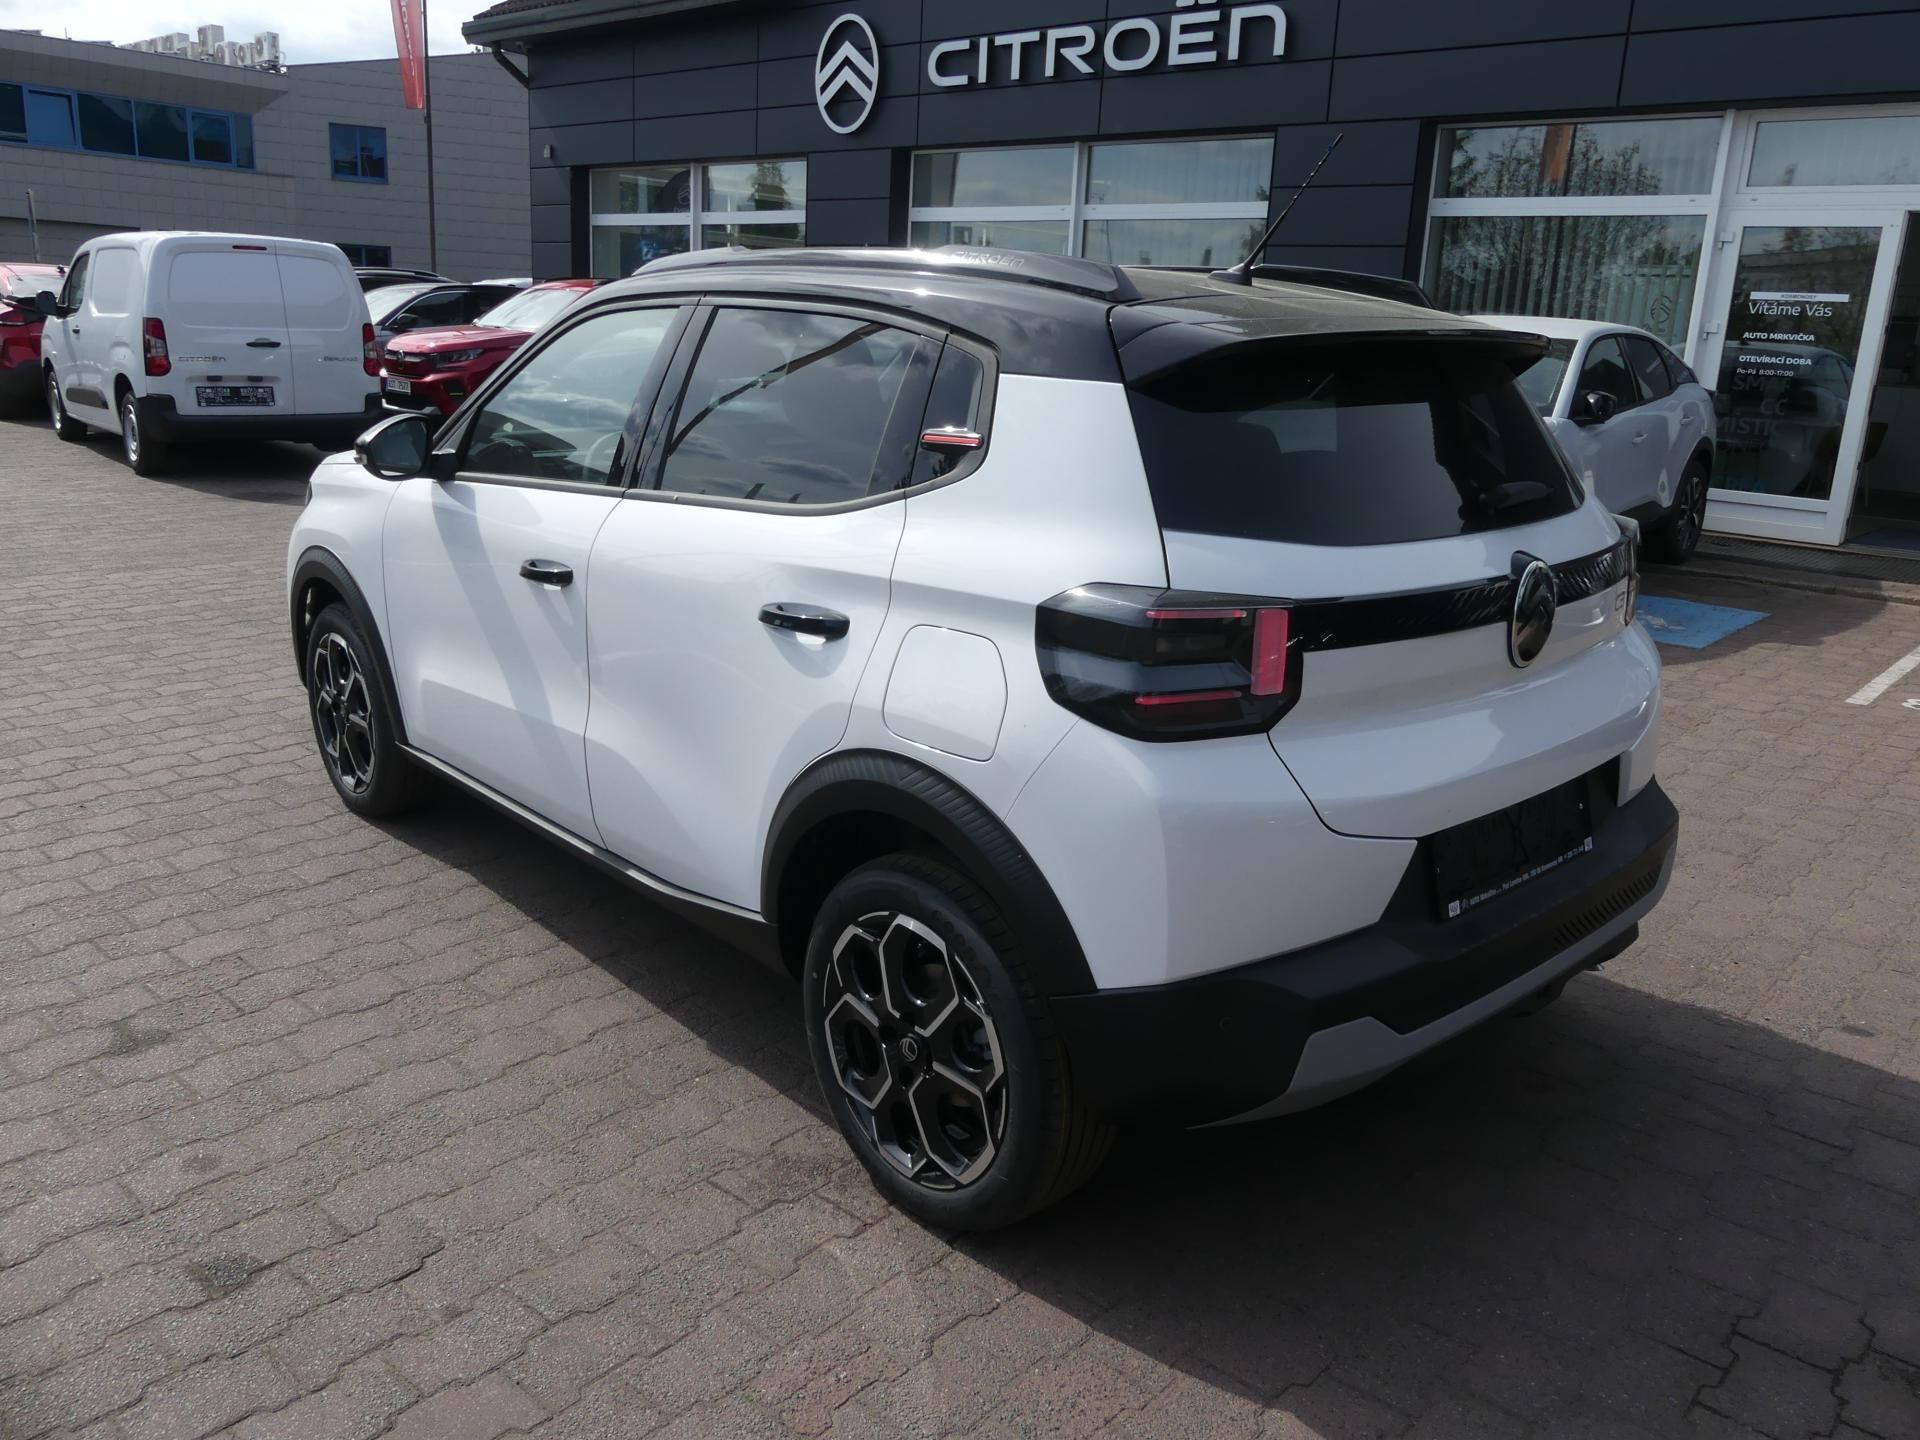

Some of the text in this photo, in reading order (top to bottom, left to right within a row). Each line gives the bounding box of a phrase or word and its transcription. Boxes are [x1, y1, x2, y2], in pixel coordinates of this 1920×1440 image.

[928, 0, 1287, 87] CITROËN
[1748, 302, 1833, 317] Vítáme Vás
[1743, 332, 1815, 342] AUTO MRKVIČKA
[1739, 355, 1813, 366] OTEVÍRACÍ DOBA
